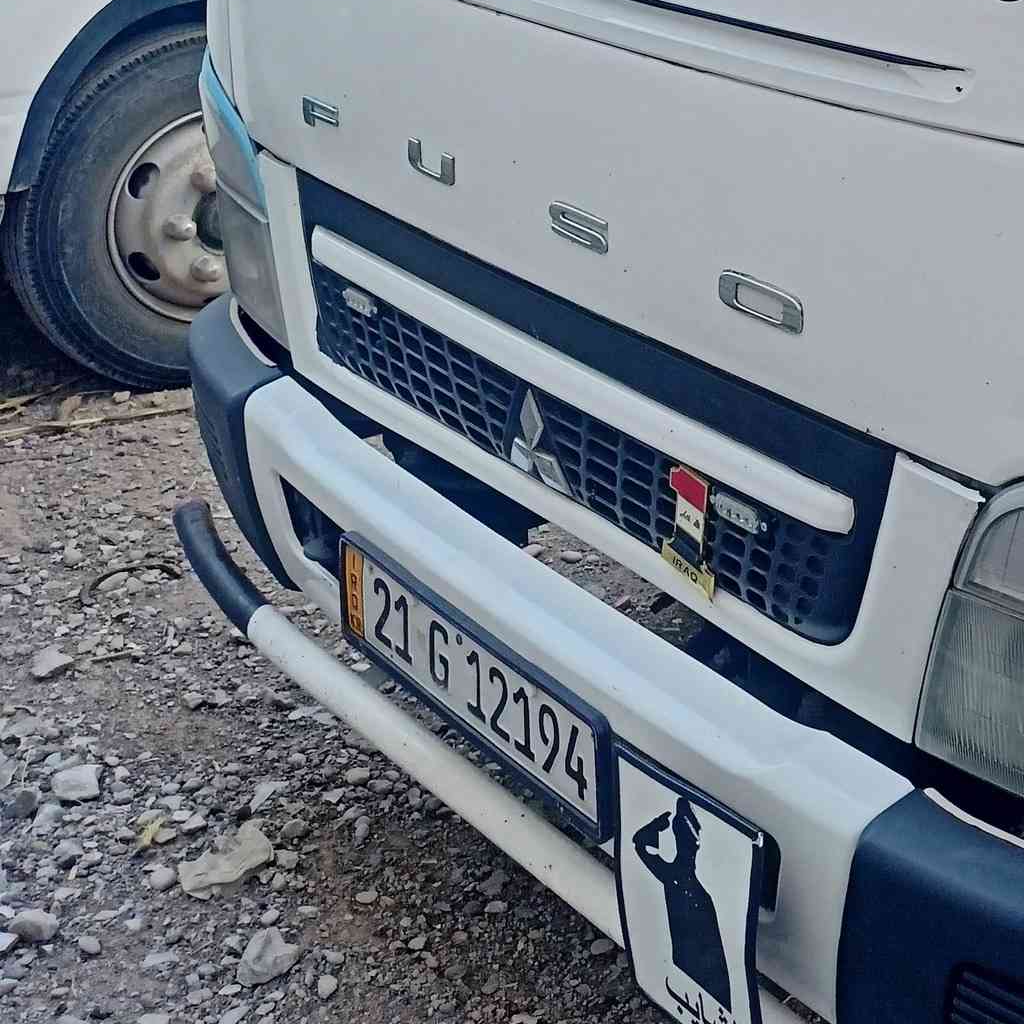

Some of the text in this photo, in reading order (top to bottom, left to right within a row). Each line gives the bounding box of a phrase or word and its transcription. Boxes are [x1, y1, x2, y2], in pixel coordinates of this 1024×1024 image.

[302, 95, 804, 335] FUSO
[671, 554, 699, 585] IRAQ
[373, 578, 588, 800] 21 G 12194
